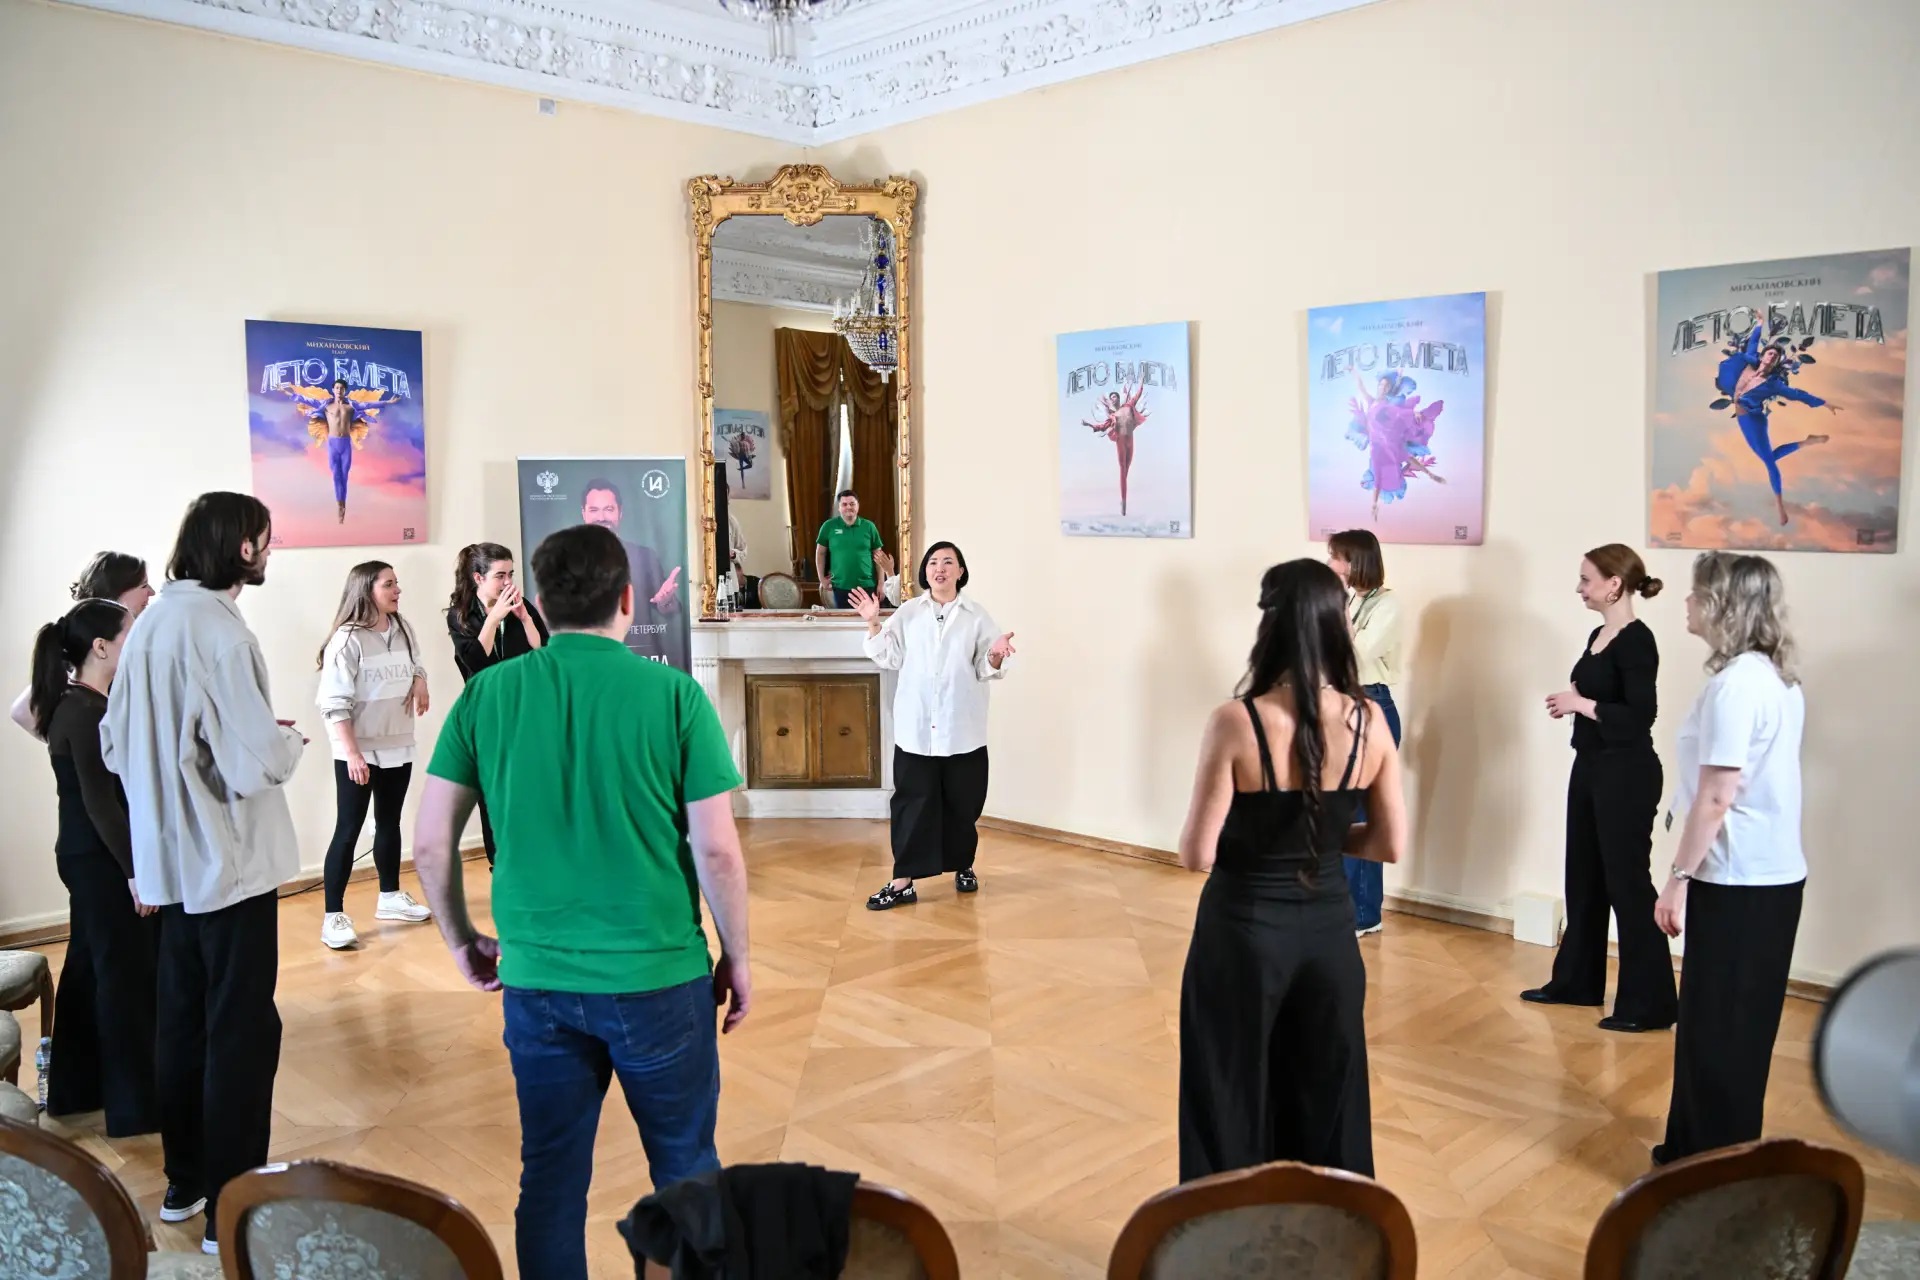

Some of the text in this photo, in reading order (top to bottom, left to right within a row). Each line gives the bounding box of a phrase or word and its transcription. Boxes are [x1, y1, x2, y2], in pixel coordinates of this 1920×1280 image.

[306, 341, 370, 351] МИХАЙЛОВСКИЙ
[1671, 300, 1885, 358] ЛЕТО БАЛЕТА
[260, 358, 411, 398] ЛЕТО БАЛЕТА
[1066, 360, 1177, 398] ЛЕТО БАЛЕТА
[1320, 340, 1469, 384] ЛЕТО БАЛЕТА
